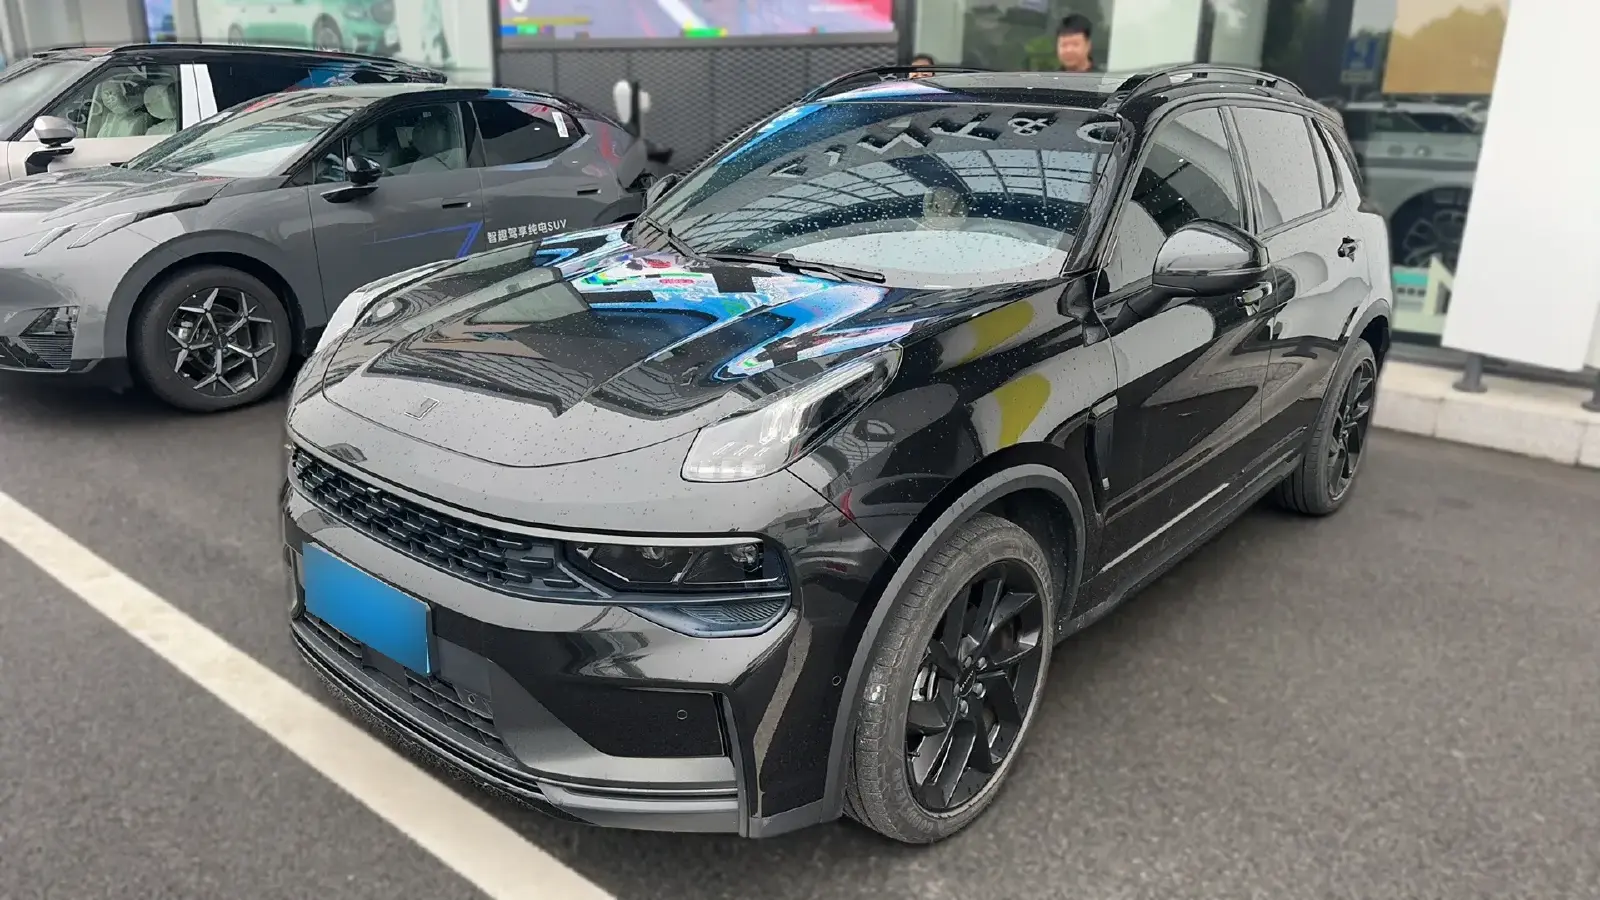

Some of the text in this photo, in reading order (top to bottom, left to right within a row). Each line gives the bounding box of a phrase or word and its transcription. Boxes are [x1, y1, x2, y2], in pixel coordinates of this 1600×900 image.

[487, 219, 567, 244] 智趣驾享纯电SUV
